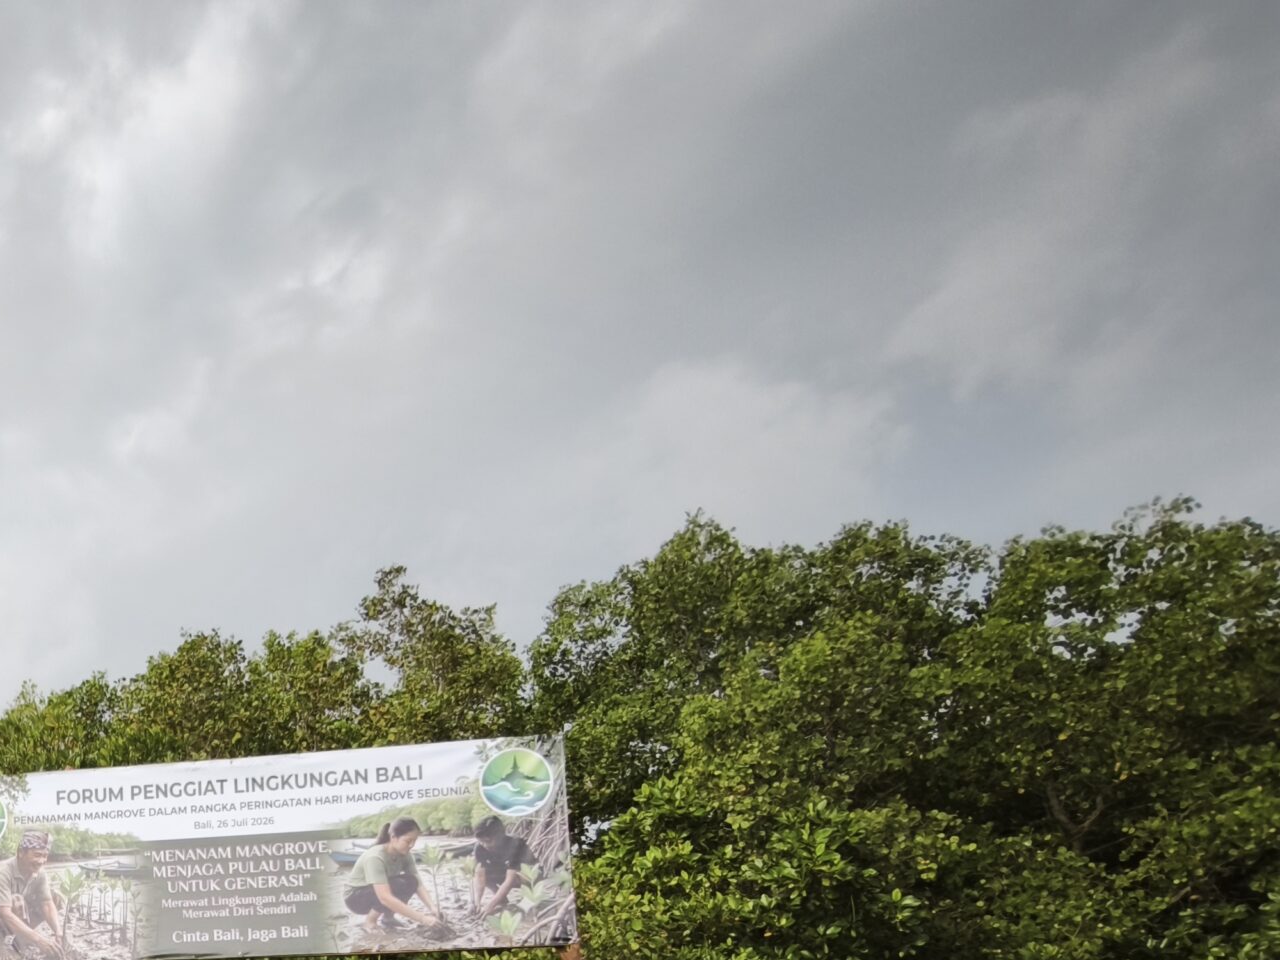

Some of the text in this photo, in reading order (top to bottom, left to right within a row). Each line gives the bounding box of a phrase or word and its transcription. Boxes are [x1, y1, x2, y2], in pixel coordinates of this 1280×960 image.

[56, 764, 424, 806] FORUM PENGGIAT LINGKUNGAN BALI
[14, 813, 81, 824] PENANAMAN
[84, 808, 146, 820] MANGROVE
[148, 806, 188, 817] DALAM
[191, 803, 236, 814] RANGKA
[240, 798, 312, 812] PERINGATAN
[315, 795, 343, 806] HARI
[346, 790, 414, 804] MANGROVE
[194, 816, 275, 831] Bali, 26 Juli 2026
[235, 840, 332, 858] MANGROVE,
[152, 857, 325, 878] MENJAGA PULAU BALI,
[166, 880, 221, 894] UNTUK
[162, 891, 318, 908] Merawat Lingkungan Adalah
[182, 904, 297, 920] Merawat Diri Sendiri
[172, 925, 309, 944] Cinta Bali, Jaga Bali
